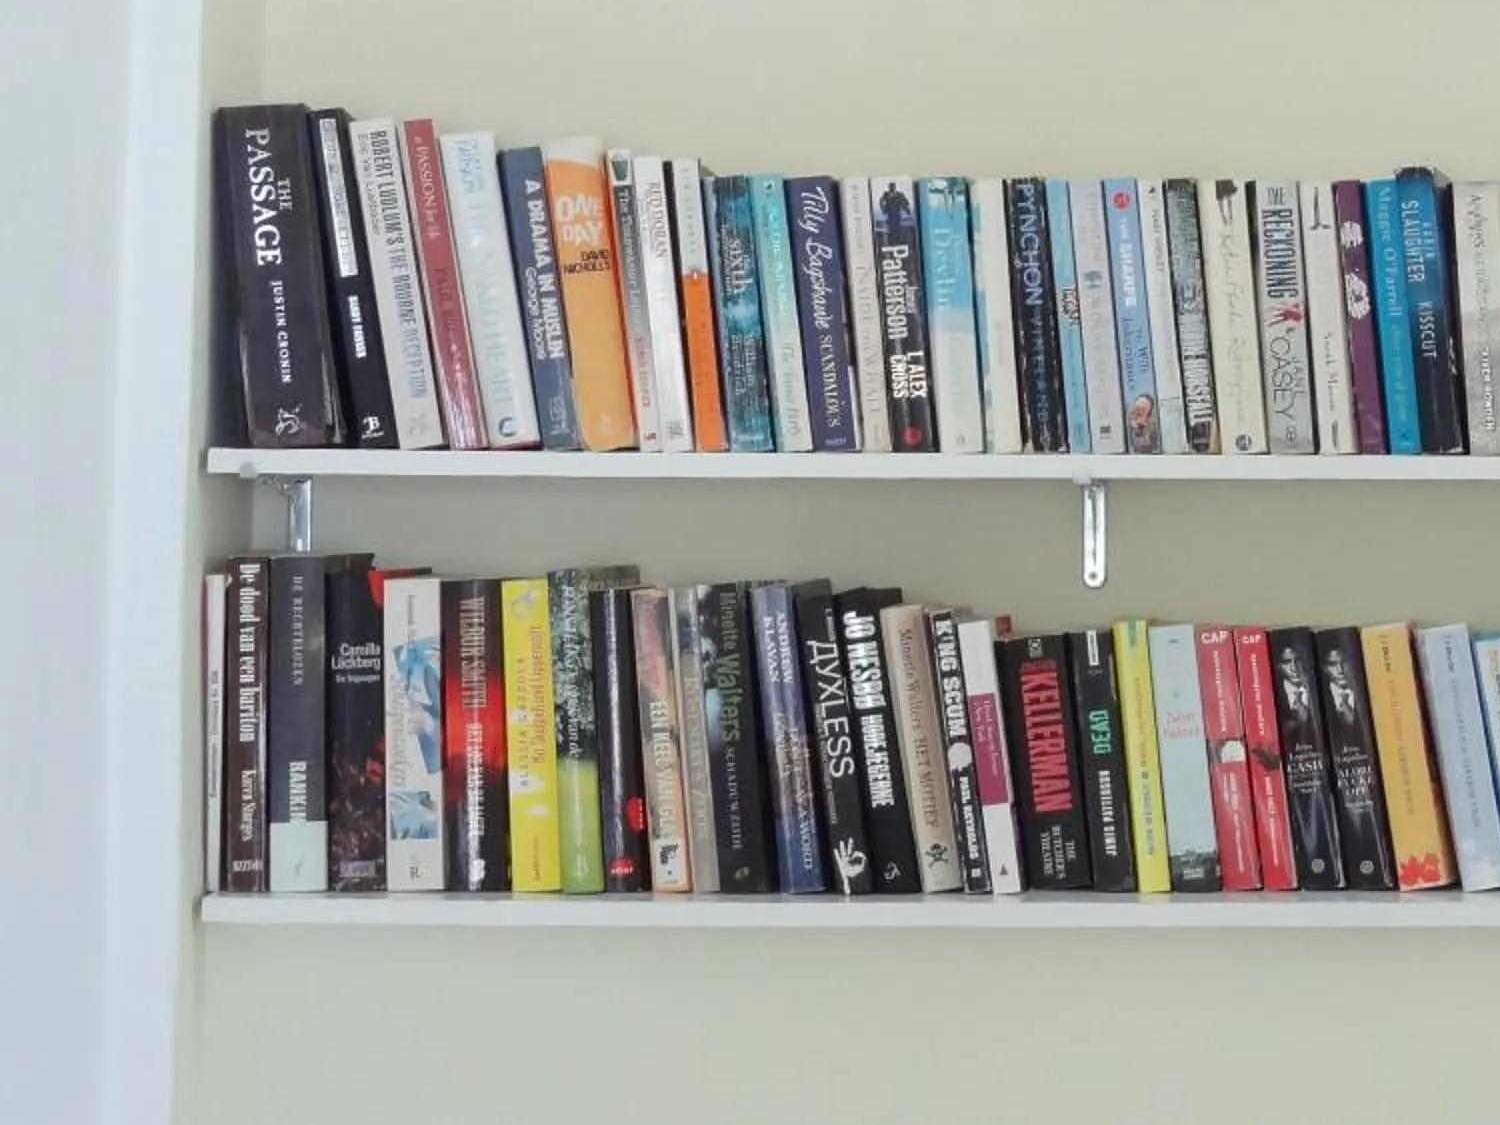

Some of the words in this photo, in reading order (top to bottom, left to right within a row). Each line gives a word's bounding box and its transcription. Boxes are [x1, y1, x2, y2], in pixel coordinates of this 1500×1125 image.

[369, 130, 396, 177] ROBERT
[415, 145, 436, 207] PASSION
[245, 128, 281, 266] PASSAGE
[277, 178, 292, 210] THE
[524, 179, 542, 194] A
[555, 192, 605, 223] ONE
[797, 187, 829, 234] Tilly
[376, 182, 404, 245] LUDLUM'S
[527, 201, 548, 268] DRAMA
[562, 218, 607, 247] DAY
[1016, 183, 1043, 306] PYNCHON
[1262, 209, 1298, 299] RECKONING
[1401, 201, 1425, 283] SLAUGHTER
[392, 274, 417, 325] BOURNE
[525, 267, 539, 316] George
[537, 274, 551, 292] IN
[803, 238, 833, 330] Bagshawe
[880, 244, 910, 340] Patterson
[1119, 243, 1137, 308] SHARPE
[270, 280, 287, 326] JUSTIN
[542, 298, 565, 358] MUSLIN
[1417, 300, 1437, 358] KISSCUT
[276, 330, 292, 383] CRONIN
[892, 354, 909, 398] CROSS
[909, 364, 927, 397] ALEX
[1269, 331, 1295, 418] CASEY
[239, 563, 261, 583] De
[239, 587, 261, 623] dood
[843, 611, 875, 637] JO
[240, 627, 259, 653] van
[775, 613, 793, 684] ANDREW
[934, 620, 957, 673] KING
[240, 656, 258, 683] een
[847, 641, 885, 710] NESBØ
[240, 686, 261, 742] bariton
[716, 653, 742, 743] Walters
[807, 640, 854, 778] ДУХLESS
[943, 677, 966, 737] SCUM
[1020, 673, 1072, 813] KELLERMAN
[1089, 708, 1111, 754] DEAD
[1065, 840, 1076, 862] THE
